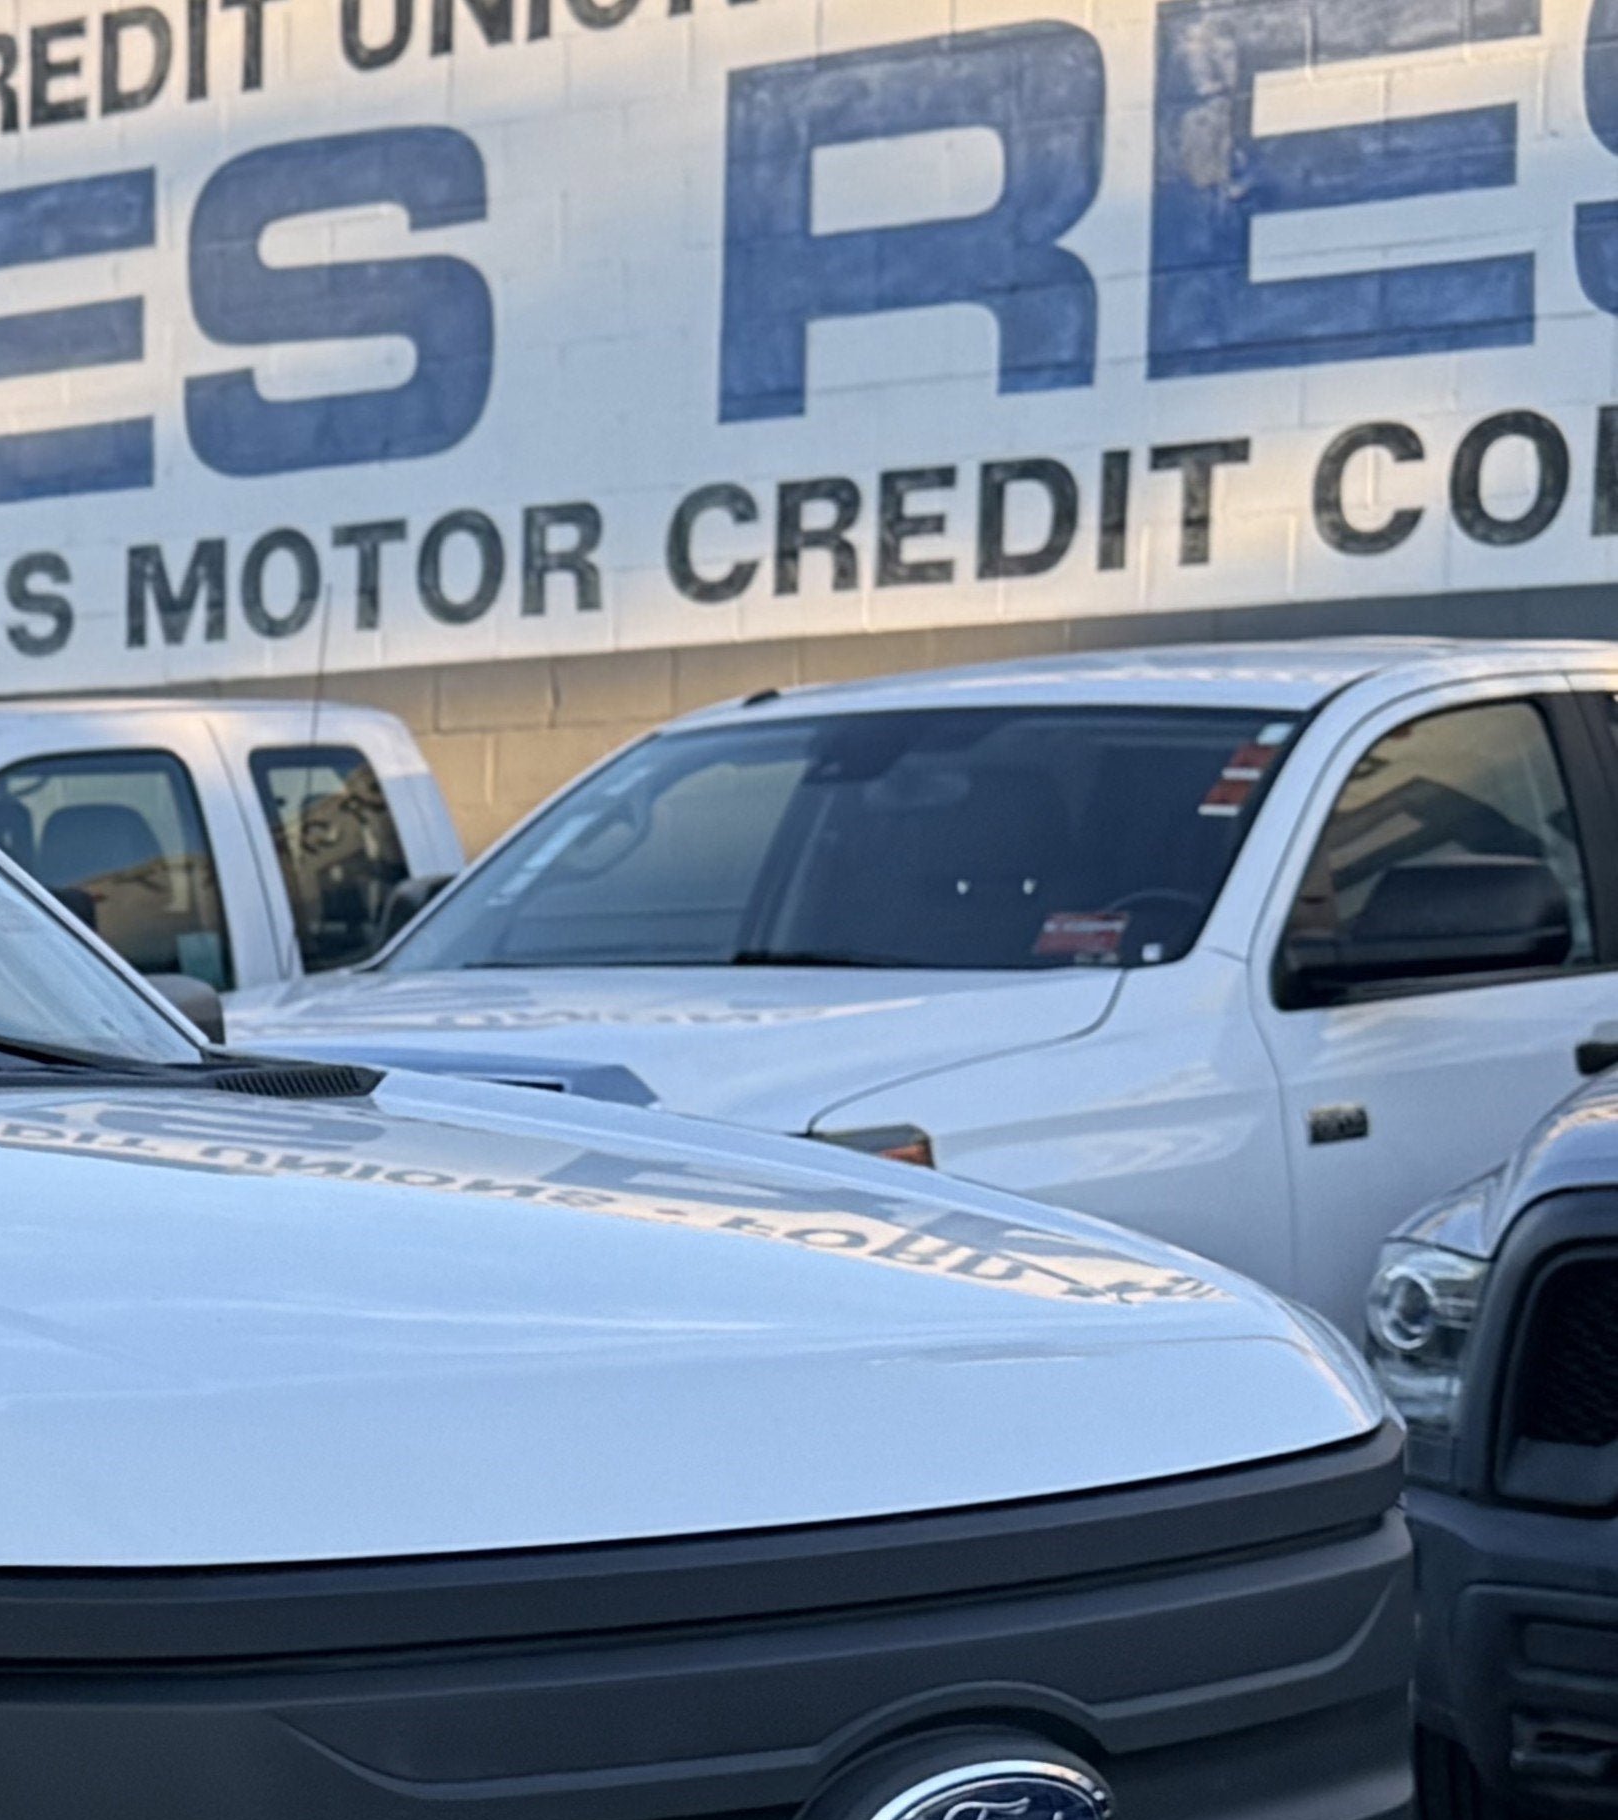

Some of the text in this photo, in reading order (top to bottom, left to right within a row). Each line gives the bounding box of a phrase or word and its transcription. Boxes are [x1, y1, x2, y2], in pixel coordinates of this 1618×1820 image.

[718, 0, 1618, 426] RE
[125, 500, 605, 650] MOTOR
[666, 436, 1253, 602] CREDIT
